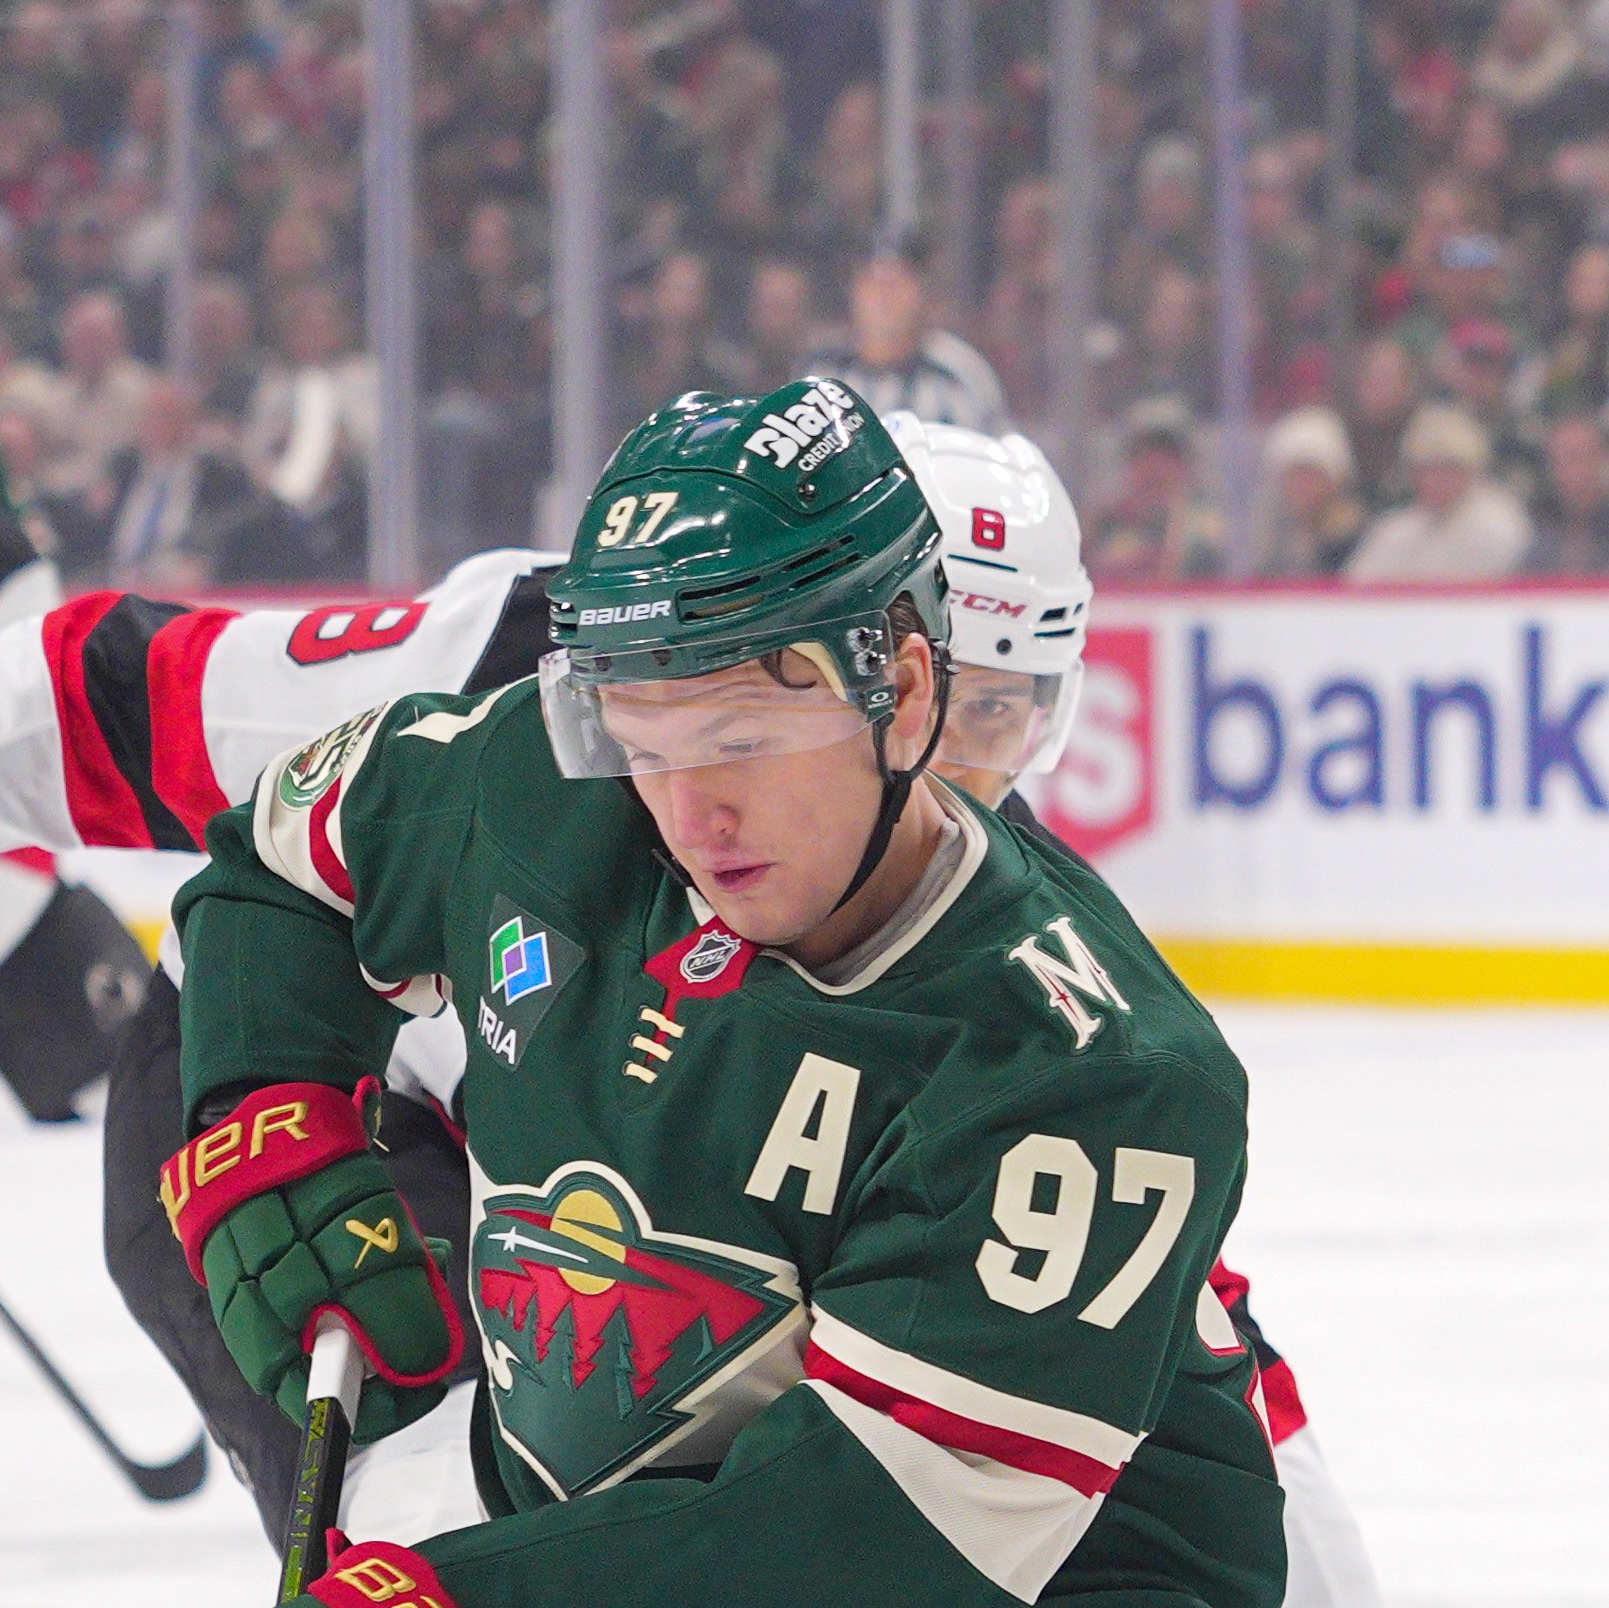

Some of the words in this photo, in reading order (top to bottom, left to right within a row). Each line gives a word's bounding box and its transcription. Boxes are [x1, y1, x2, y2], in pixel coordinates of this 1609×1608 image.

[744, 381, 854, 469] Blaze
[798, 433, 839, 472] CREDIT
[597, 491, 679, 547] 97
[971, 506, 1007, 552] 8
[578, 599, 672, 627] BAUER
[1190, 624, 1608, 812] bank
[744, 1052, 862, 1216] A
[975, 1133, 1195, 1330] 97
